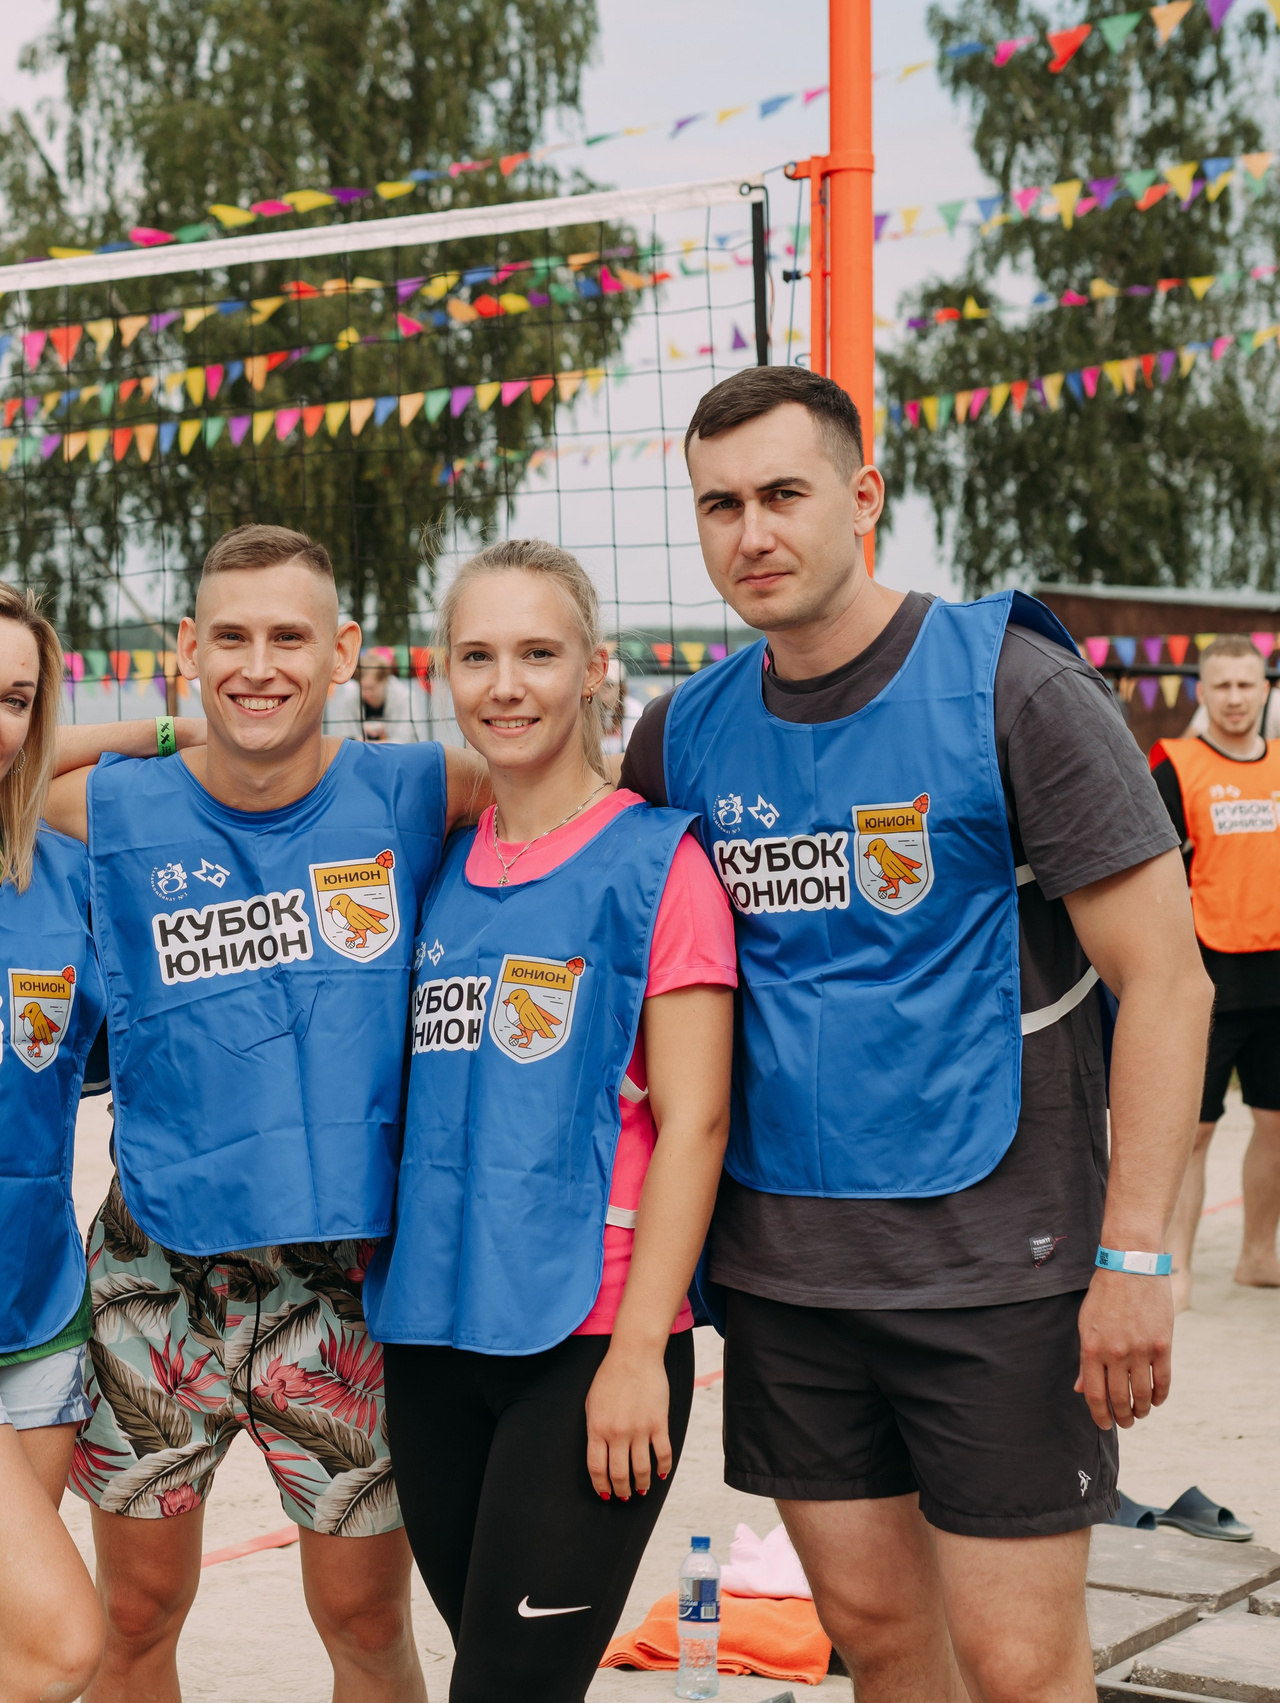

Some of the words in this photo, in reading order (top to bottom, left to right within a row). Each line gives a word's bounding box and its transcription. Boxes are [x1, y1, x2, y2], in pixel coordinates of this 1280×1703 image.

[865, 815, 915, 829] ЮНИОН
[718, 837, 845, 876] КУБОК
[323, 870, 381, 885] ЮНИОН
[726, 875, 846, 909] ЮНИОН
[158, 894, 304, 948] КУБОК
[164, 929, 308, 979] ЮНИОН
[20, 981, 65, 994] ЮНИОН
[511, 967, 567, 984] ЮНИОН
[414, 983, 486, 1017] УБОК
[414, 1018, 481, 1049] НИОН
